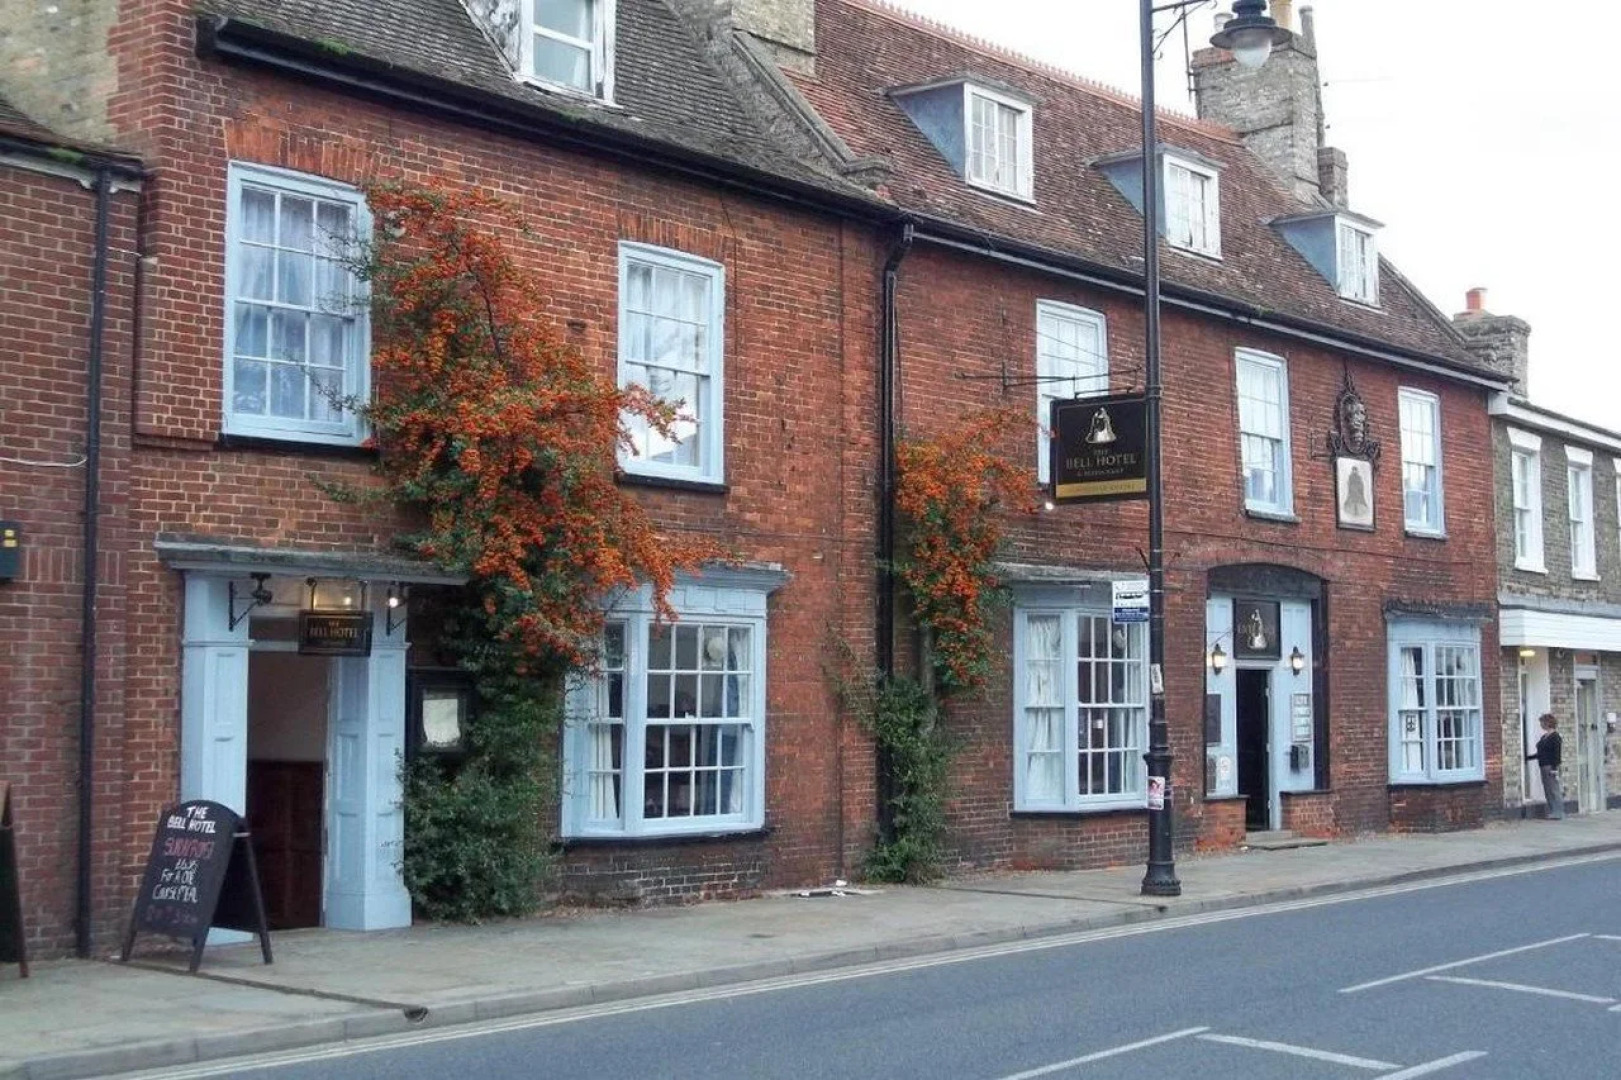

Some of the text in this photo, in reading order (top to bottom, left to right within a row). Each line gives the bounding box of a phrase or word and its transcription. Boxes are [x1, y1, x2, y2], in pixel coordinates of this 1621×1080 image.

[1066, 453, 1137, 469] BELL HOTEL
[186, 806, 209, 819] THE
[166, 815, 216, 834] BELL HOTEL
